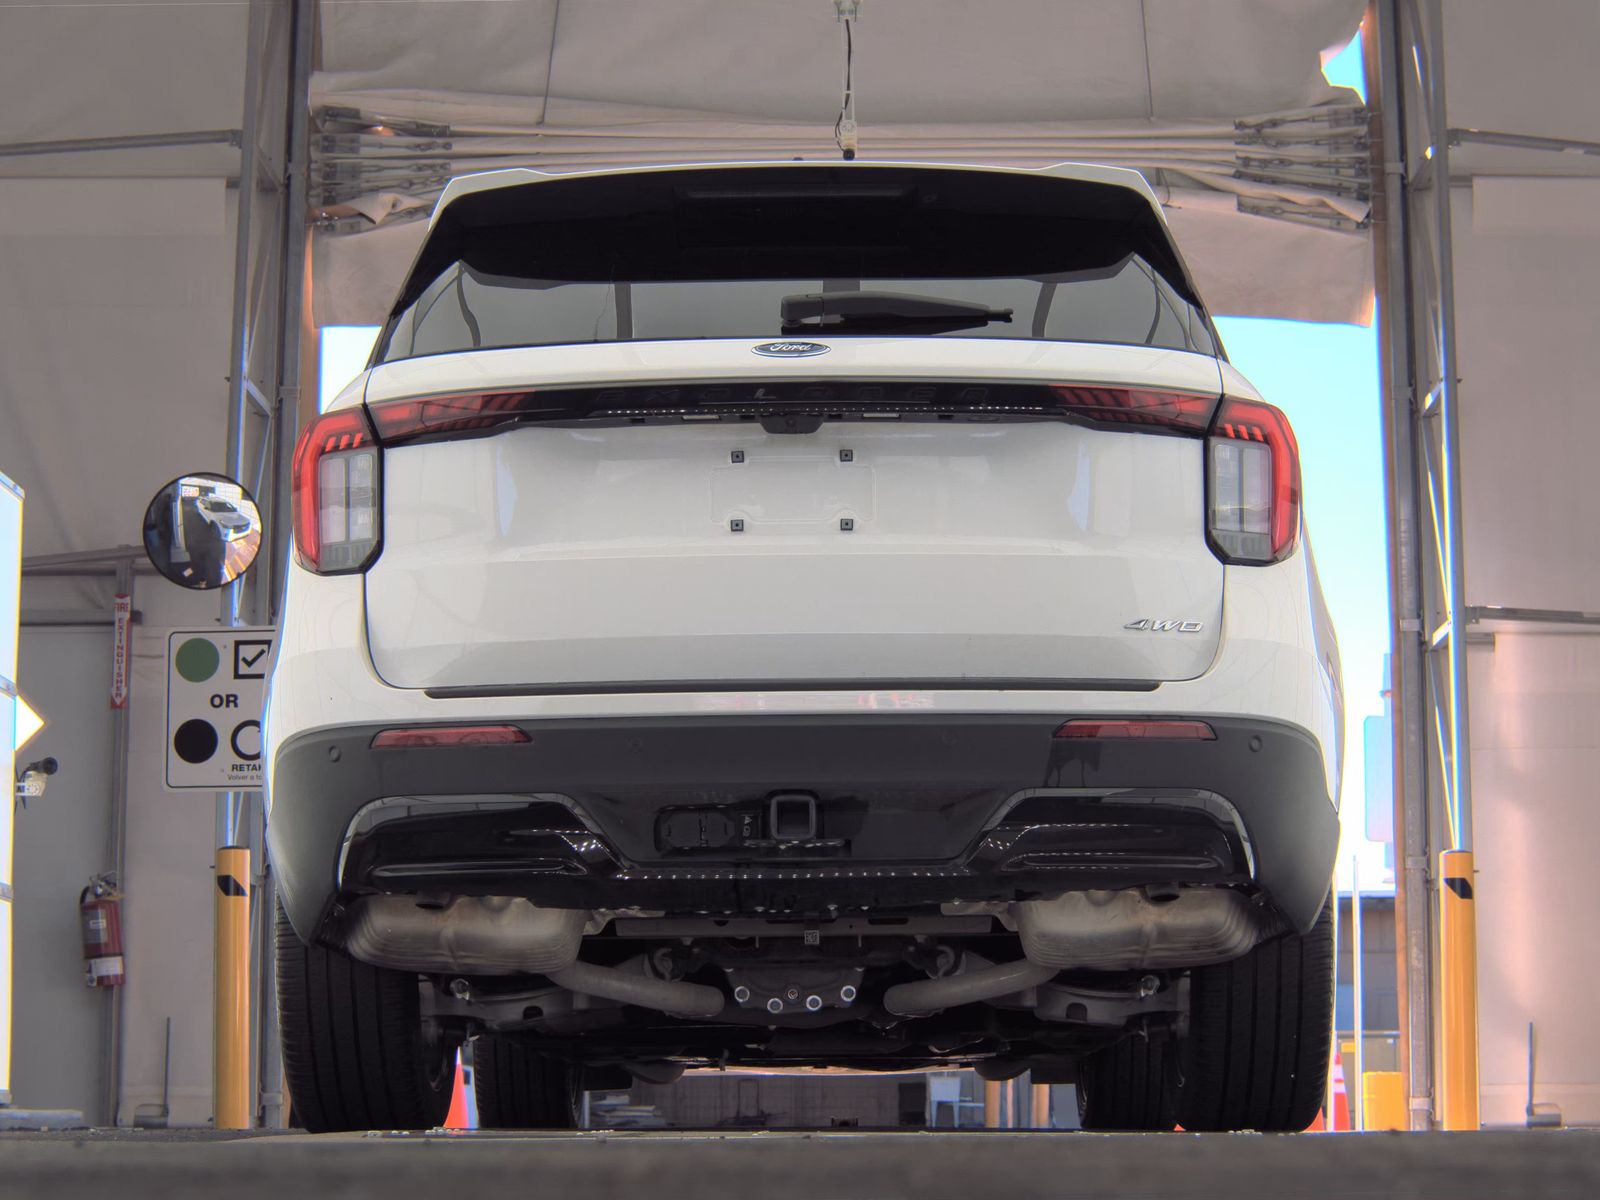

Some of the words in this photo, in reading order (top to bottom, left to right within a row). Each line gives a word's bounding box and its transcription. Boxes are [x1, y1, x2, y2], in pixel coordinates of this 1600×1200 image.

[1123, 619, 1203, 632] 4WD
[115, 617, 124, 698] EXTINGUISHER
[210, 693, 239, 708] OR
